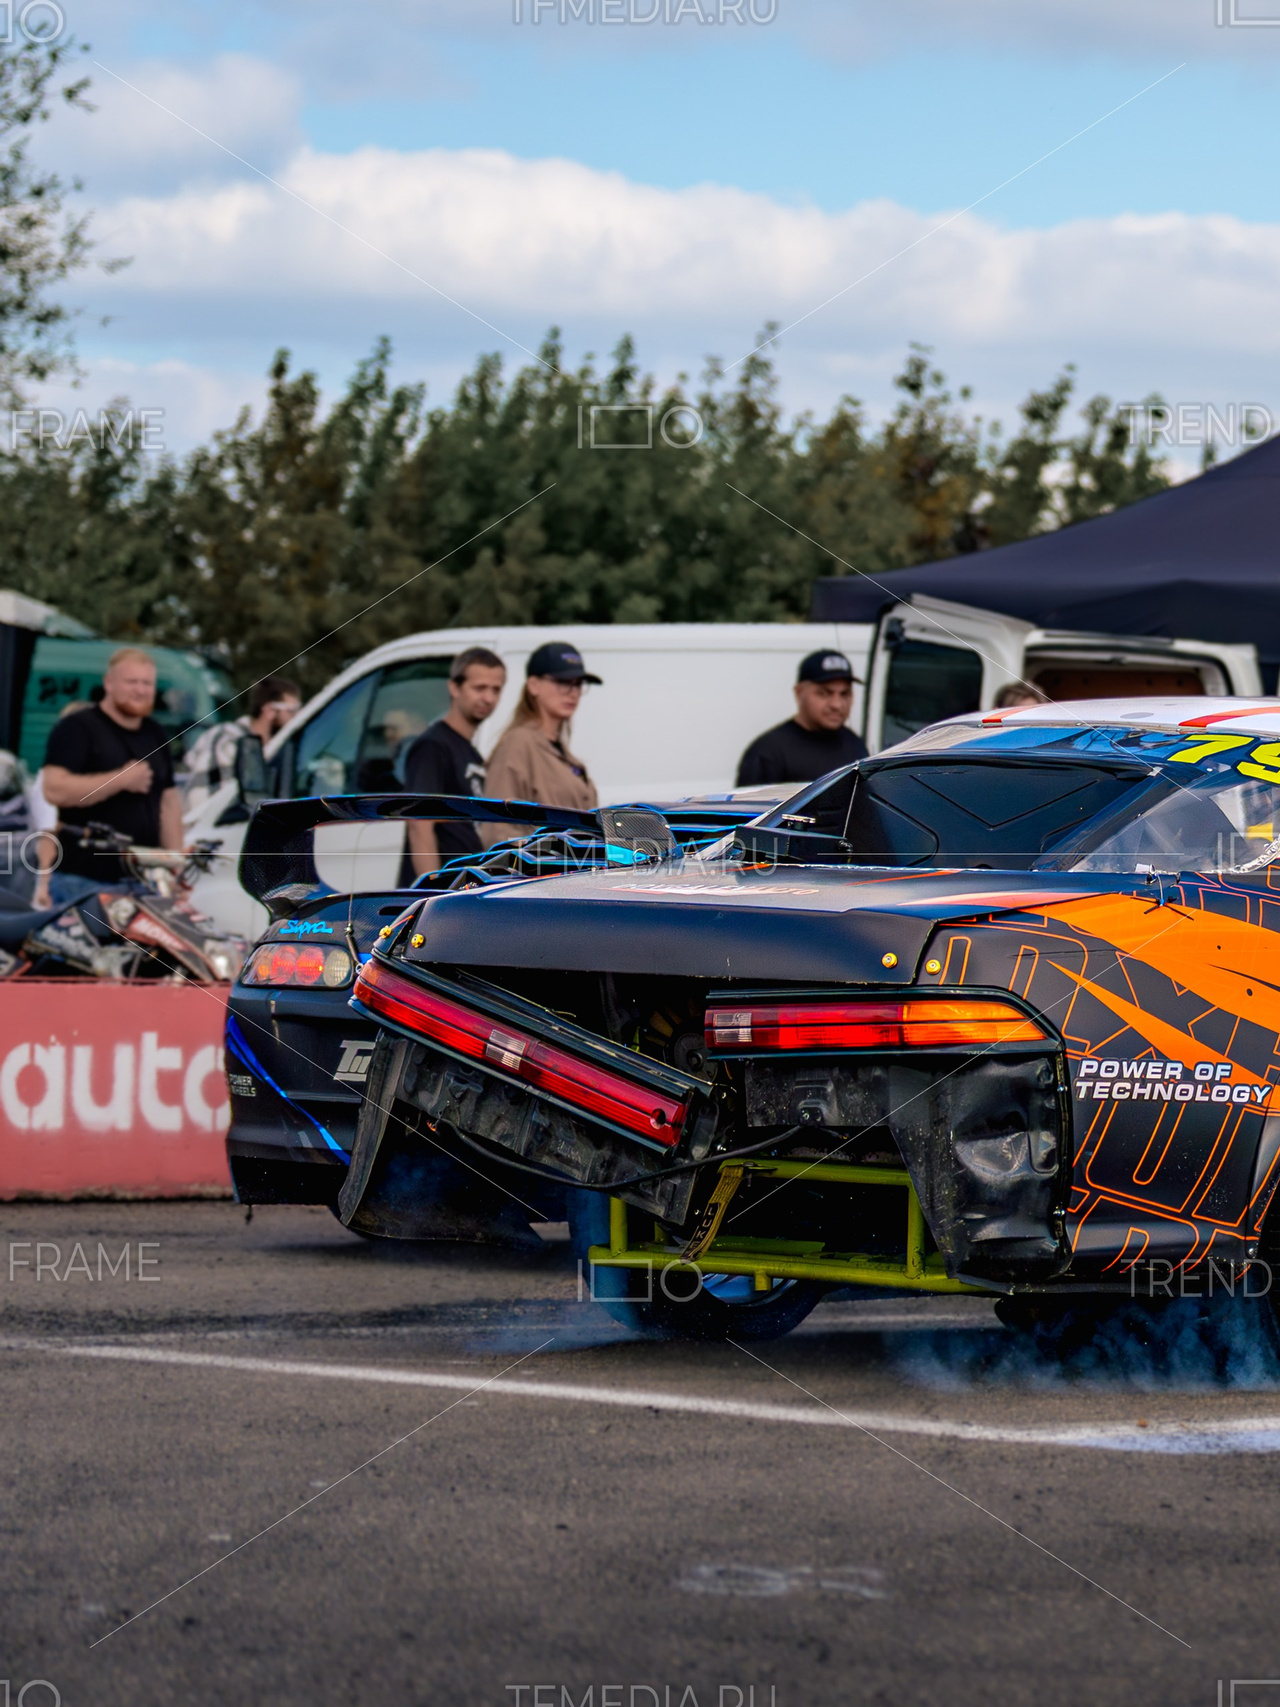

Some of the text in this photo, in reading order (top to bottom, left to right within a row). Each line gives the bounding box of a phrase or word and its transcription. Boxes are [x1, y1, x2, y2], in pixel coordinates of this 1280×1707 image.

[279, 920, 333, 939] Supra
[1079, 1060, 1232, 1081] POWER OF
[1075, 1080, 1272, 1104] TECHNOLOGY
